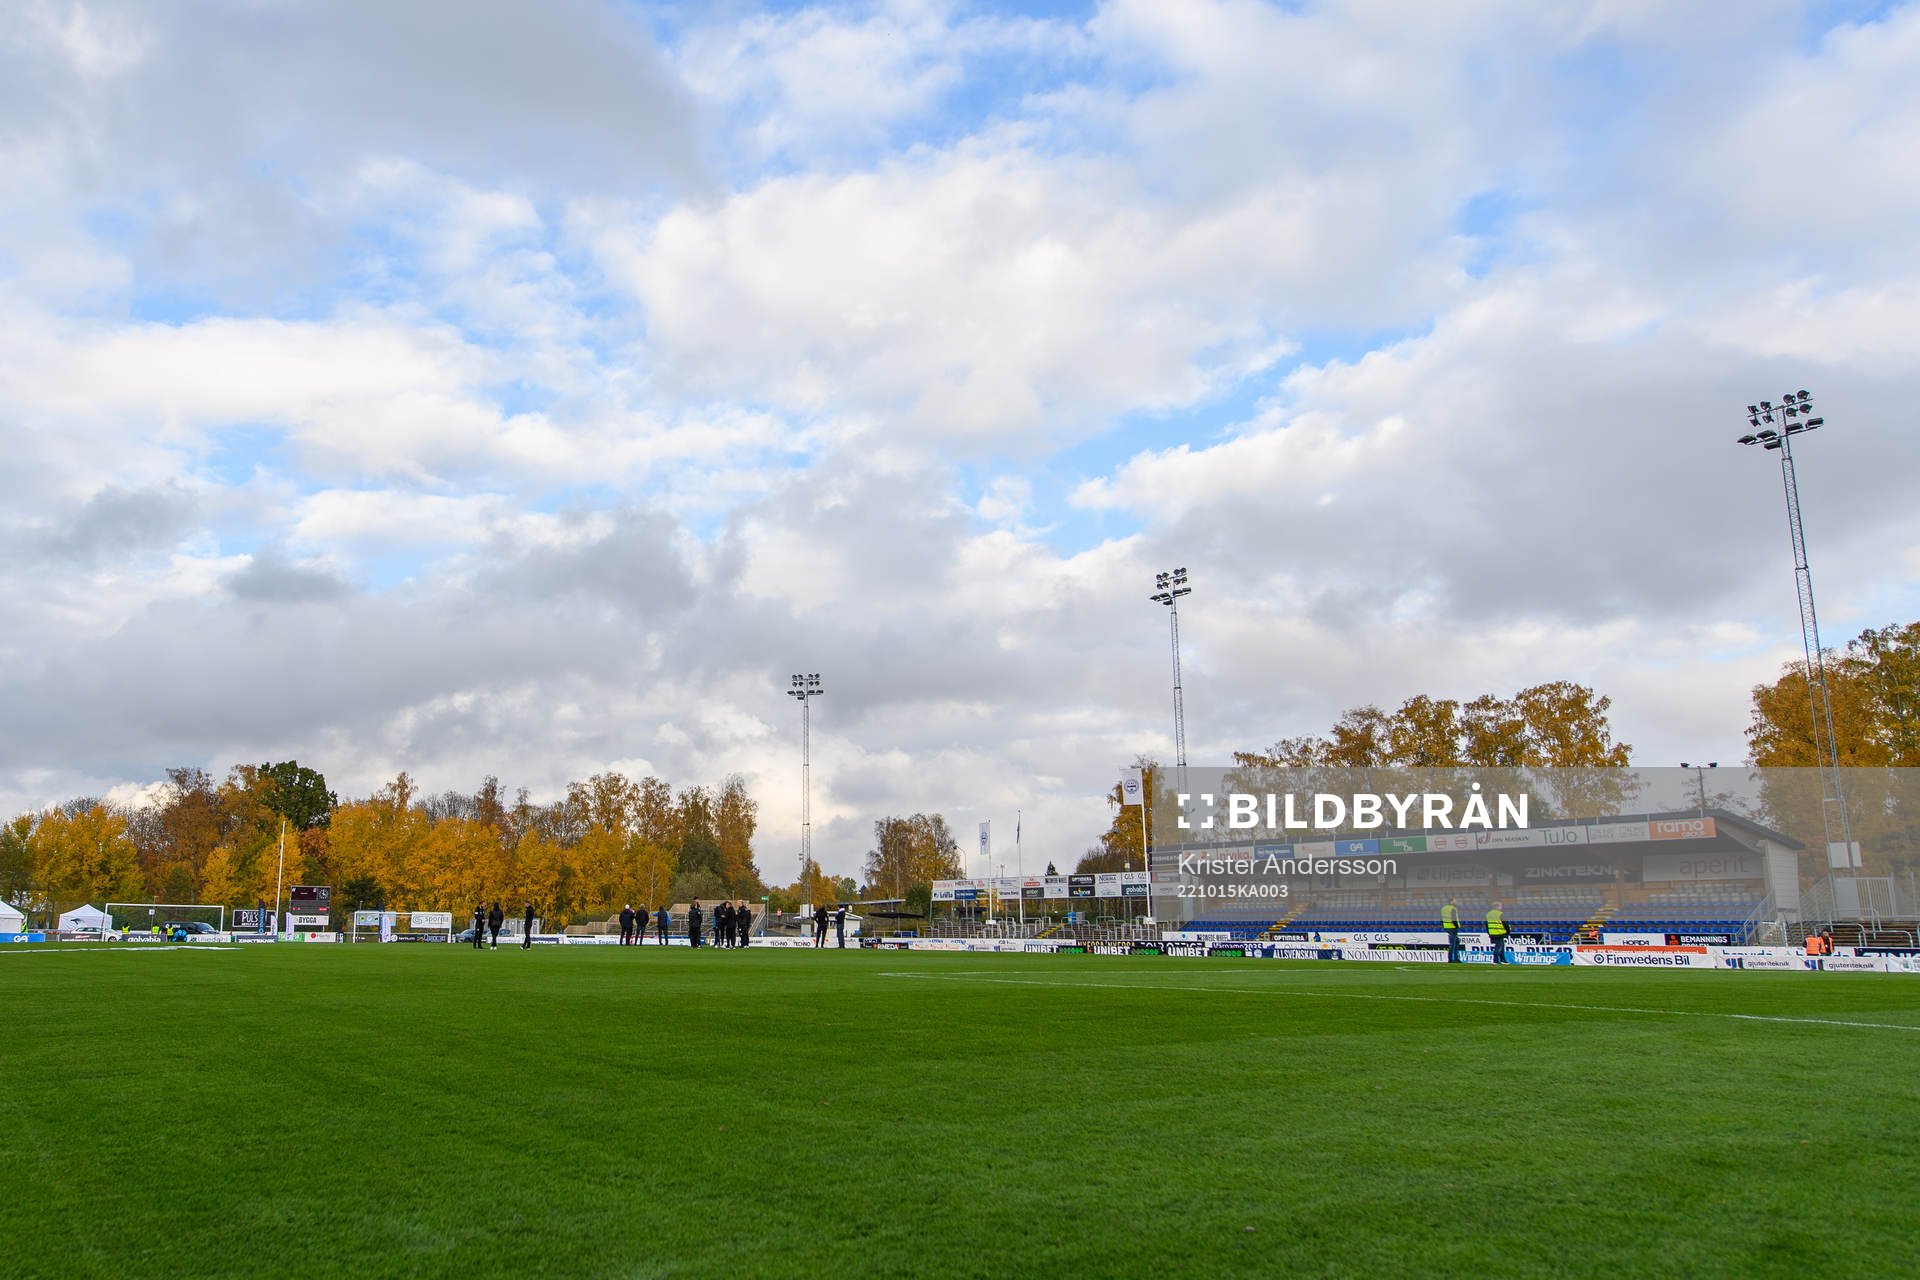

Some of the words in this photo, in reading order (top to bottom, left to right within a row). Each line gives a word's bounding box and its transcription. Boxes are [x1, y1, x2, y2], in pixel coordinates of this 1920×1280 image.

[1656, 820, 1705, 833] ramo
[1679, 854, 1749, 879] aperit
[1353, 934, 1368, 942] GLS
[1374, 934, 1390, 942] GLS
[1680, 935, 1728, 944] BEMANNINGS
[1025, 944, 1059, 954] UNIBET
[1093, 946, 1131, 955] UNIBET
[1167, 947, 1209, 957] UNIBET
[1272, 949, 1319, 960] ALLSVENSKAN
[1346, 950, 1392, 961] NOMINIT
[1398, 951, 1445, 961] NOMINIT
[1514, 952, 1558, 964] Windings
[1606, 953, 1673, 966] Finnvedens
[1674, 954, 1691, 966] Bil
